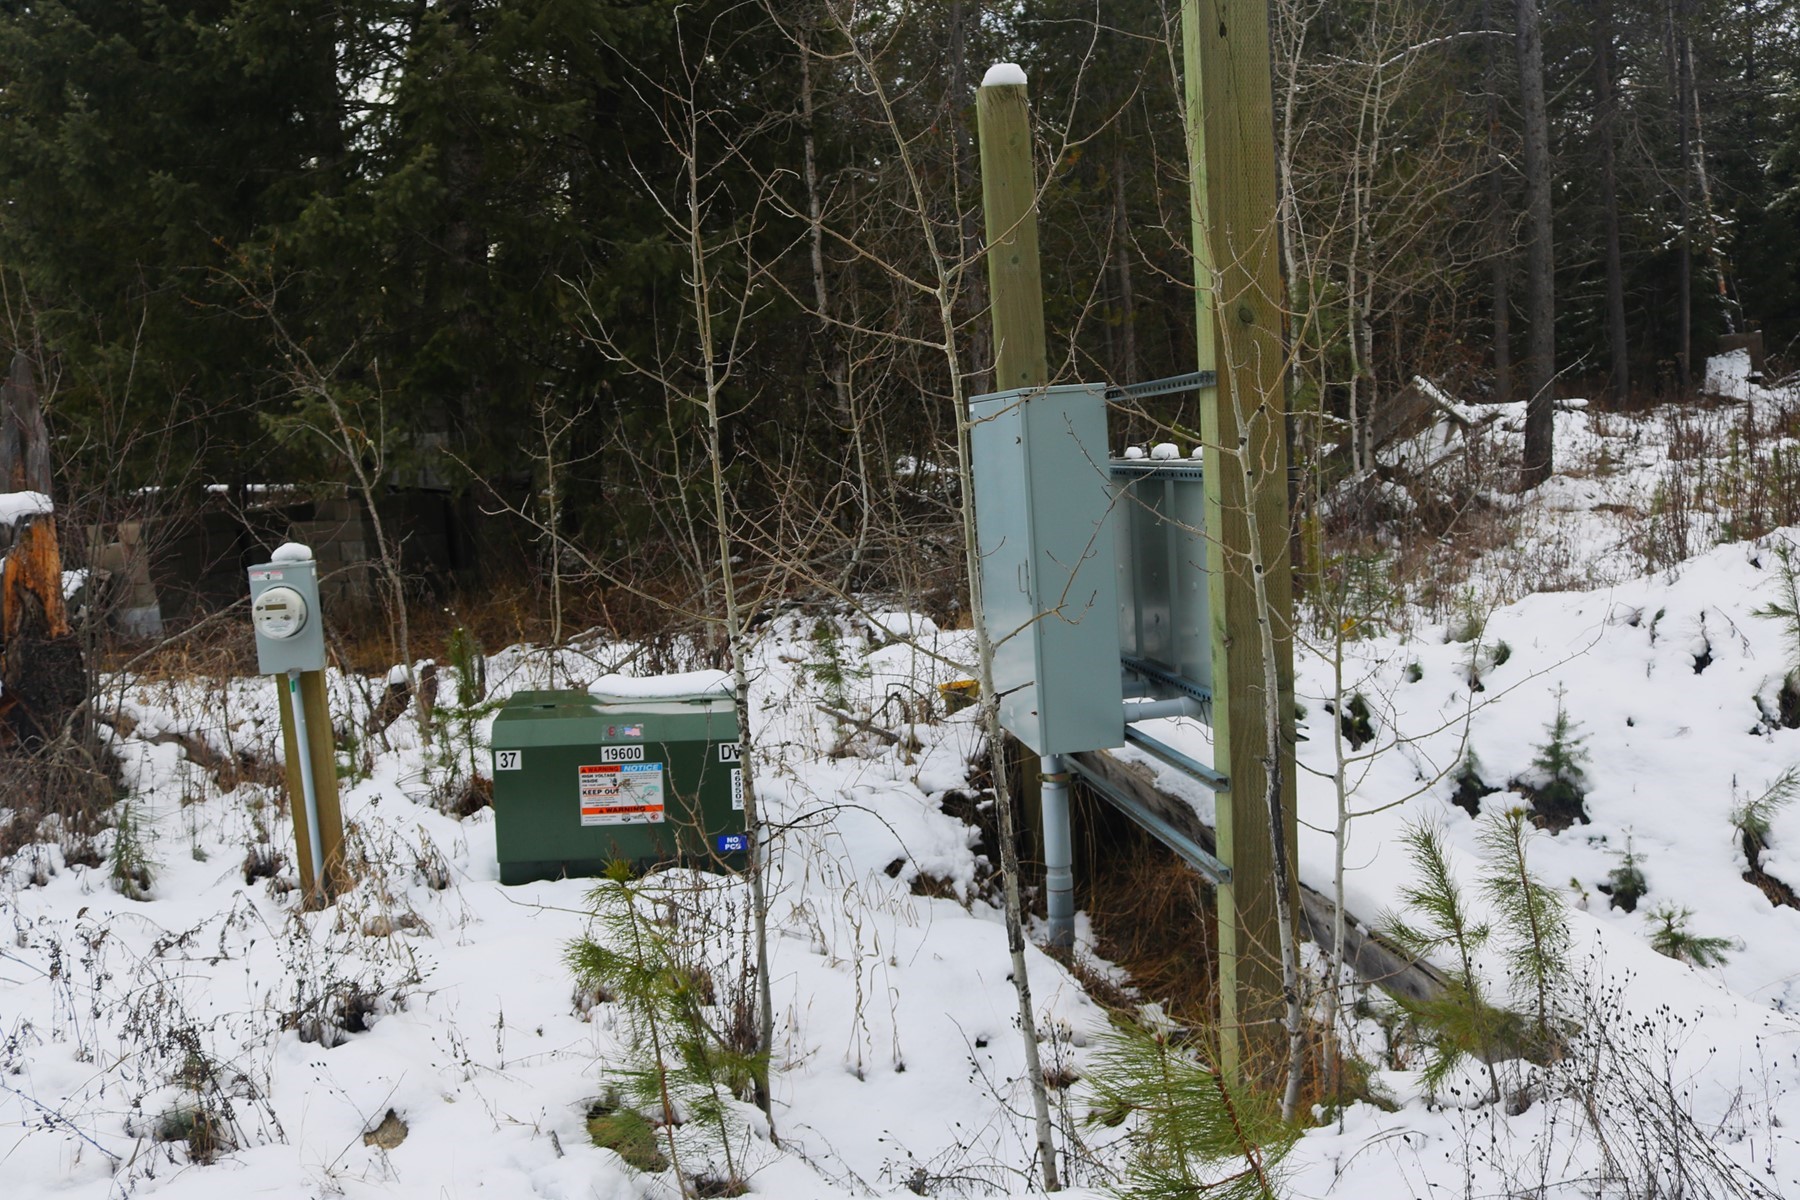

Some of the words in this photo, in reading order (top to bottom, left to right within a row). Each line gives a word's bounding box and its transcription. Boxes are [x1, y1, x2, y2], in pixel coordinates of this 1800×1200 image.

[500, 752, 517, 768] 37
[604, 747, 641, 760] 19600
[623, 764, 659, 772] NOTICE
[734, 770, 742, 799] 46950
